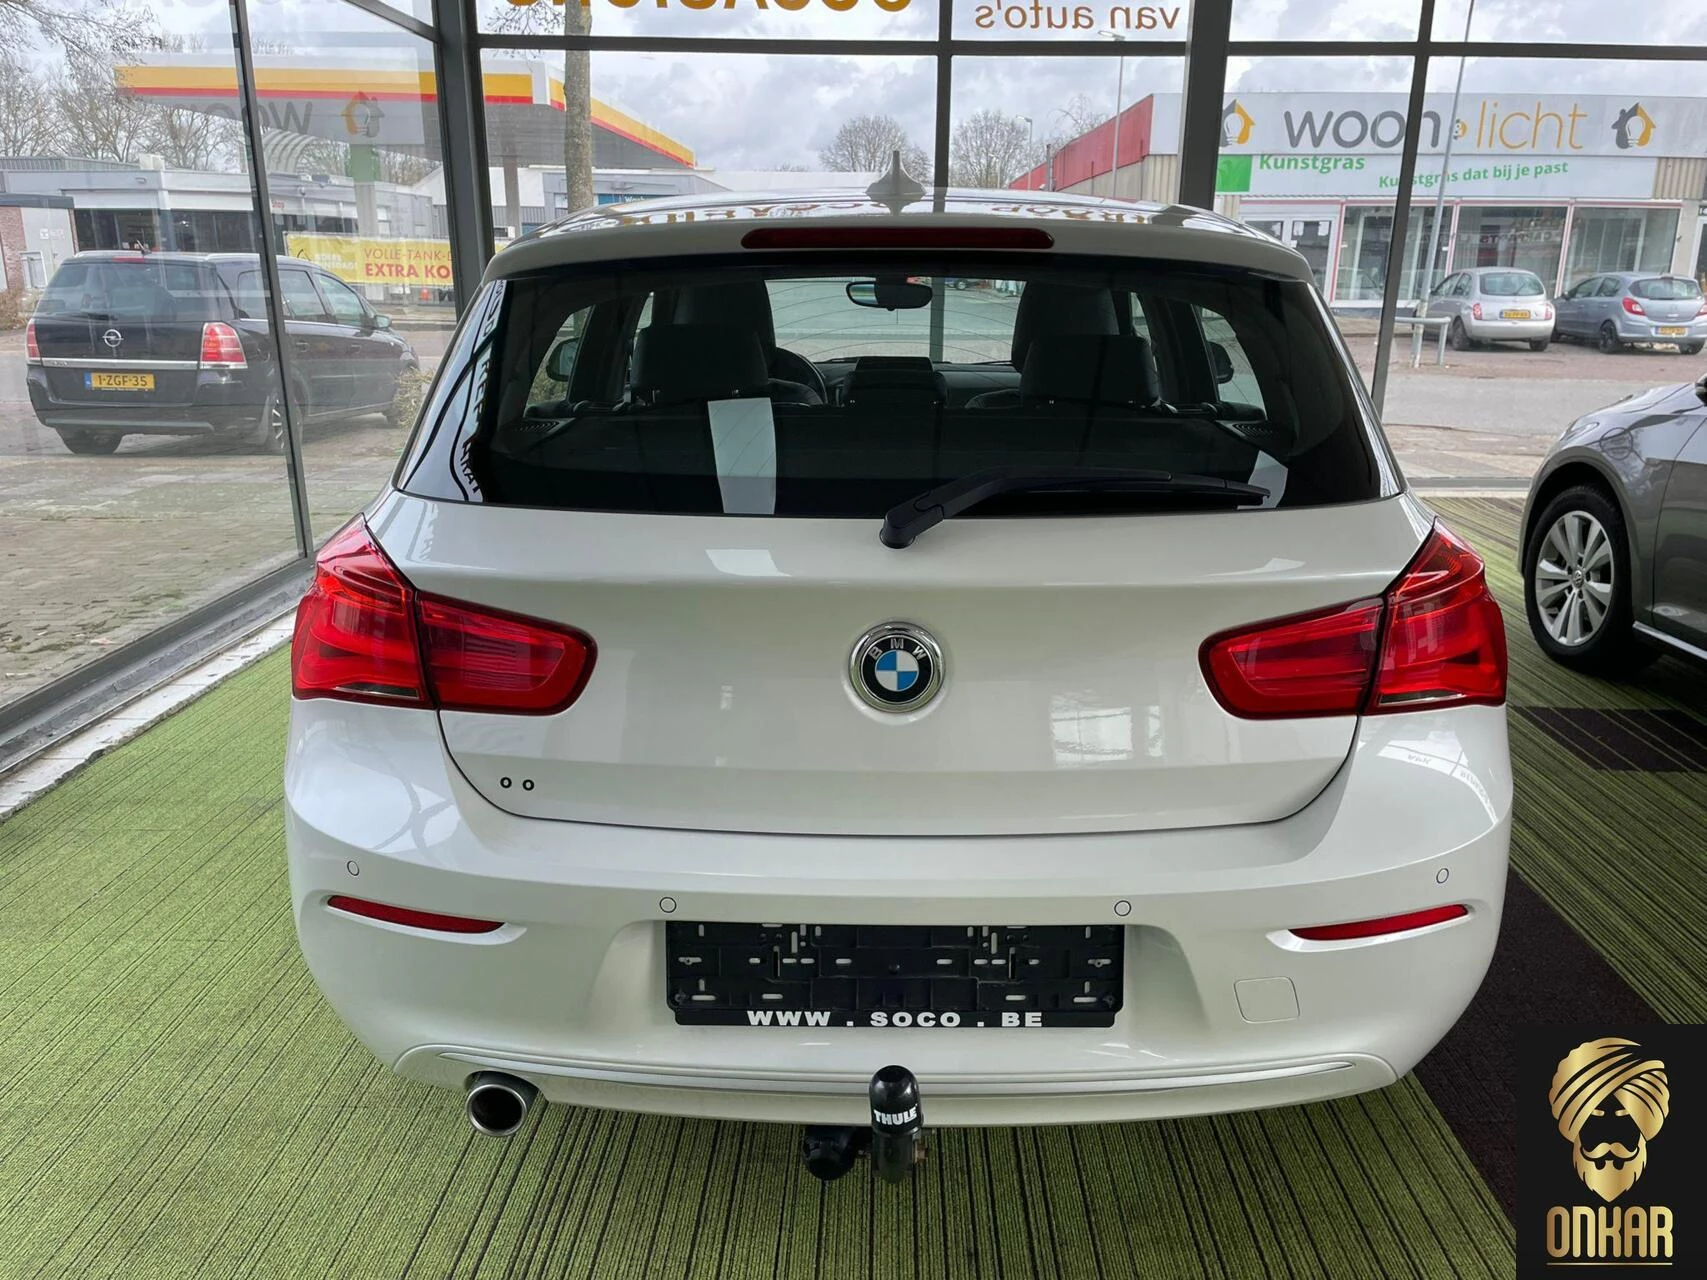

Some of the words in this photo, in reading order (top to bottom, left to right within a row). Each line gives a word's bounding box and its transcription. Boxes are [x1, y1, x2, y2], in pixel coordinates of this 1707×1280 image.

[1476, 100, 1589, 150] licht
[1258, 154, 1366, 174] Kunstgras
[1463, 167, 1489, 182] dat
[1493, 164, 1512, 181] bij
[1515, 164, 1530, 180] je
[1534, 161, 1569, 178] past
[365, 263, 419, 278] EXTRA
[868, 637, 928, 661] BMW
[746, 1010, 831, 1027] WWW
[870, 1011, 961, 1028] SOCO
[1001, 1011, 1043, 1028] BE
[873, 1105, 918, 1126] THULE
